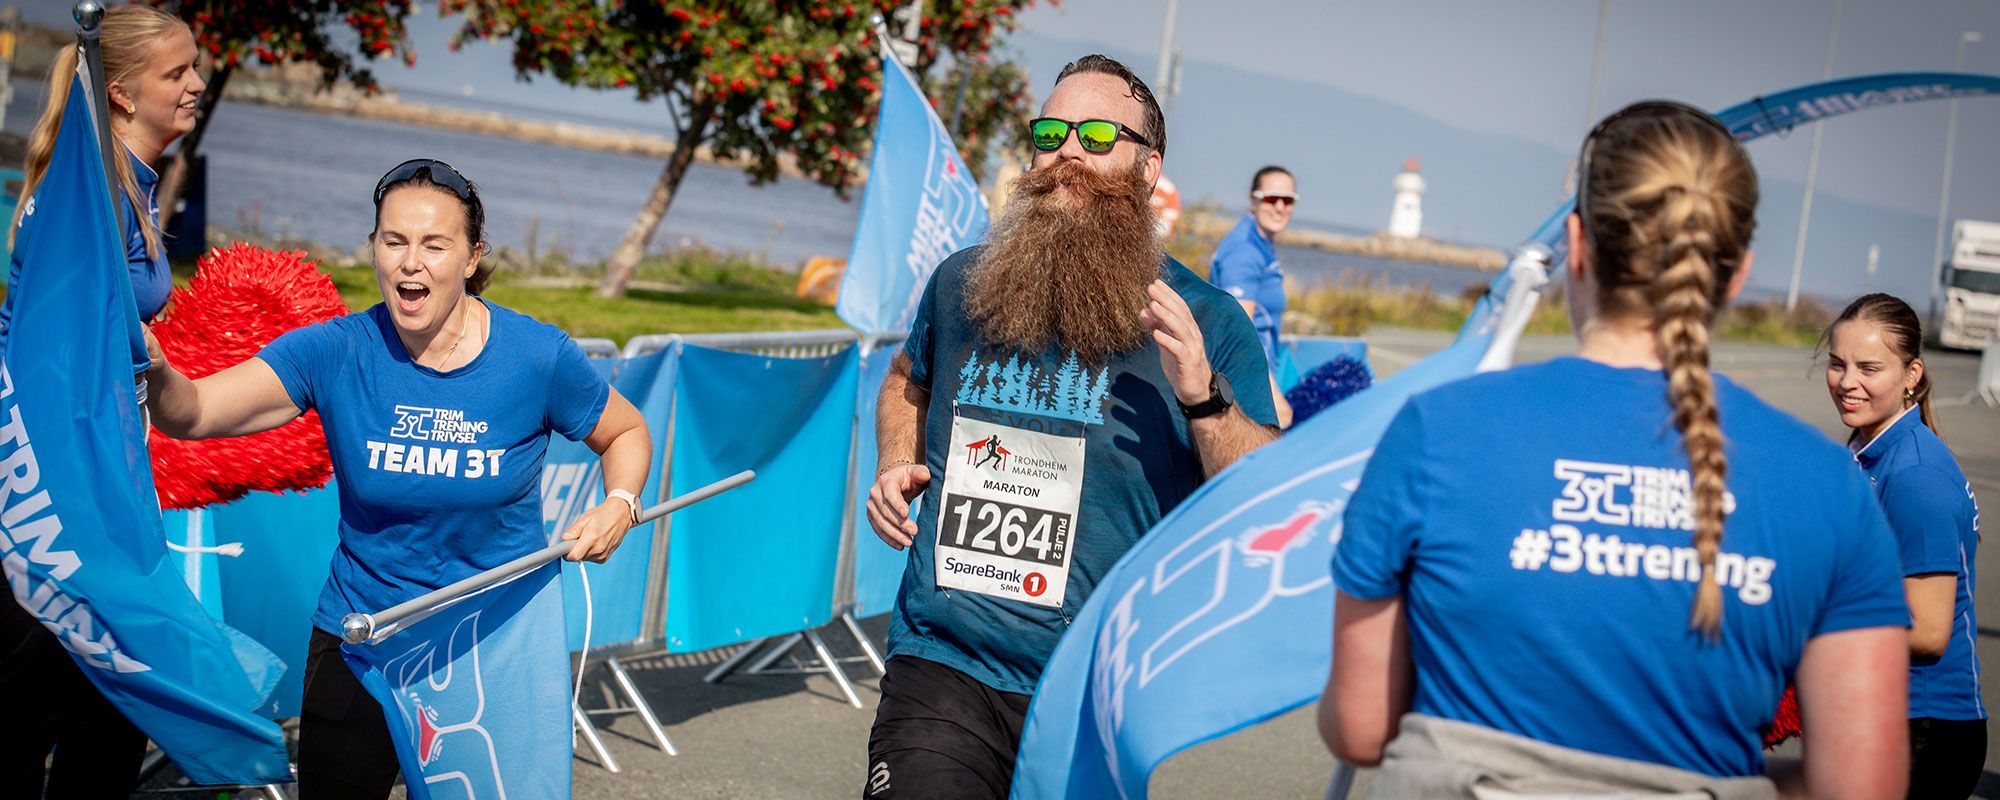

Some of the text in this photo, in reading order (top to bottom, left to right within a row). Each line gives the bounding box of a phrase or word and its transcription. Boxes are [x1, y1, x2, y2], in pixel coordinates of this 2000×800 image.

[435, 408, 464, 421] TRIM
[433, 419, 489, 433] TRENING
[430, 430, 477, 444] TRIVSEL
[366, 440, 507, 479] TEAM 3T
[1013, 455, 1068, 473] TRONDHEIM
[1011, 466, 1058, 481] MARATON
[1632, 466, 1690, 487] TRIM
[0, 403, 83, 582] TRIM
[983, 480, 1041, 498] MARATON
[1630, 503, 1698, 531] TRIVS
[953, 499, 1053, 561] 1264
[1053, 518, 1067, 560] PULJE 2
[944, 557, 1021, 584] SpareBank
[1509, 524, 1777, 605] #3ttrenng
[1000, 583, 1020, 593] SMN
